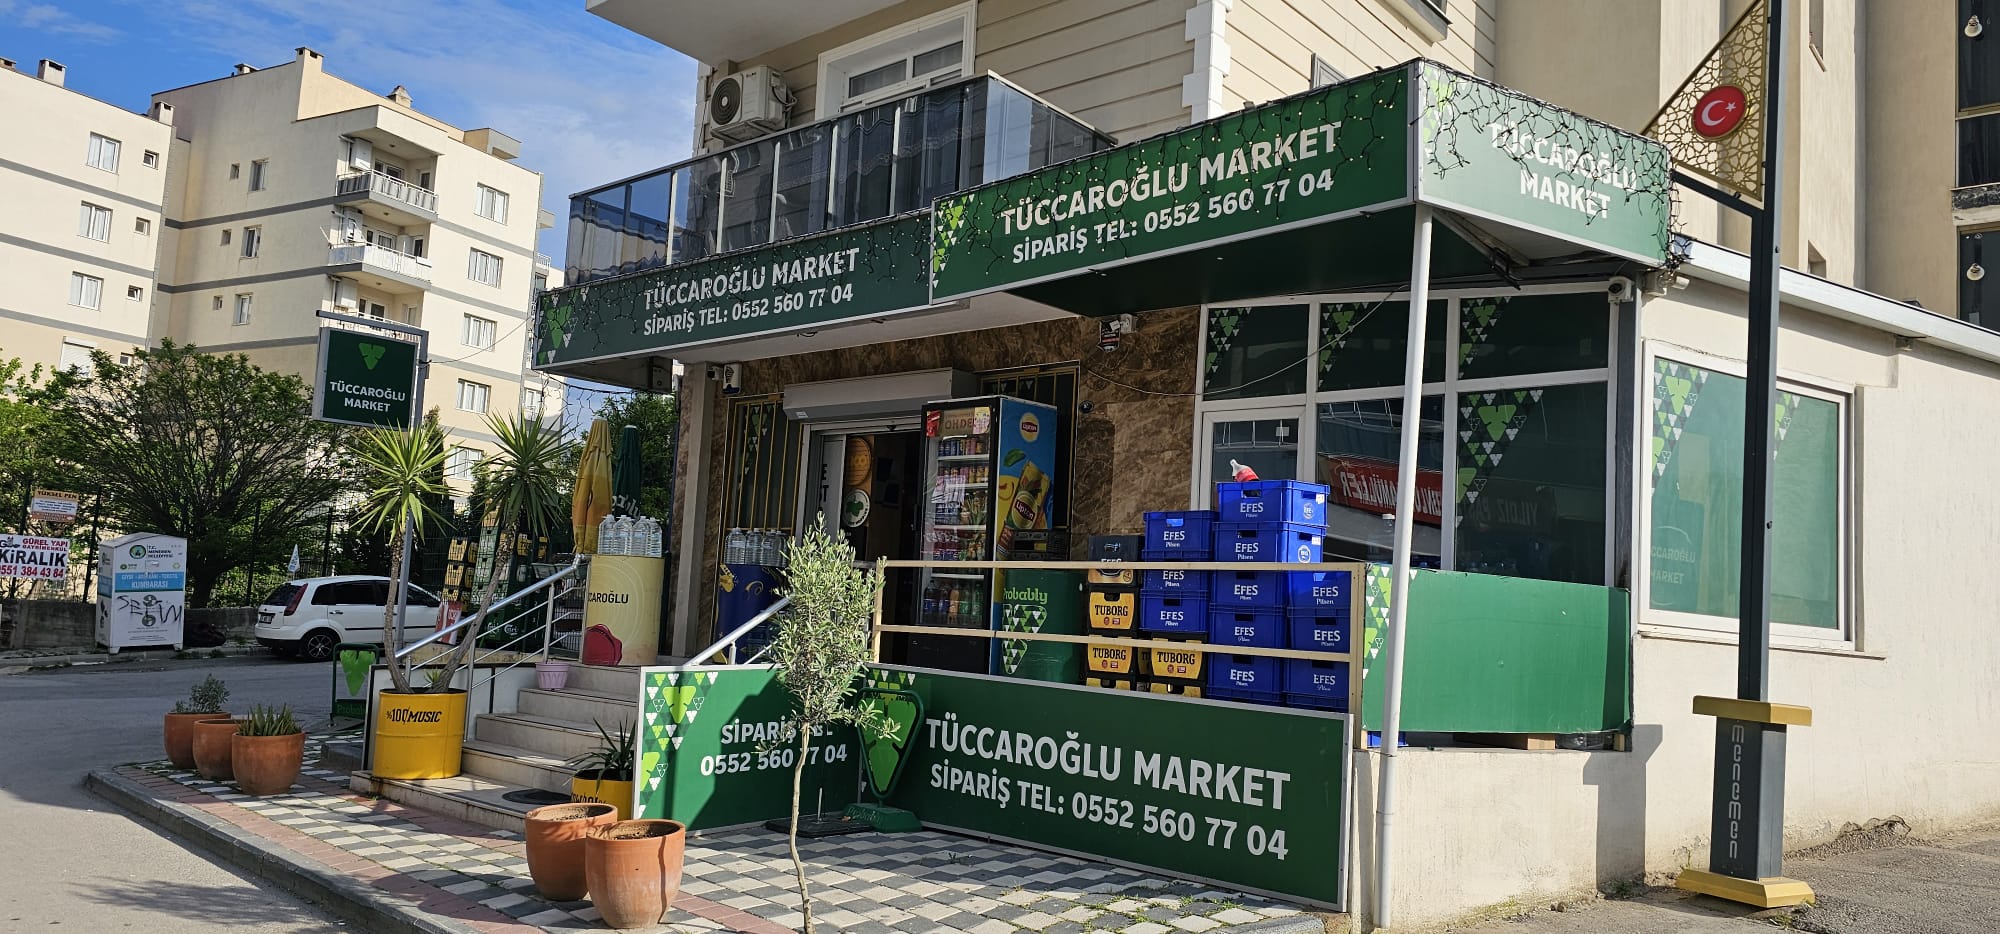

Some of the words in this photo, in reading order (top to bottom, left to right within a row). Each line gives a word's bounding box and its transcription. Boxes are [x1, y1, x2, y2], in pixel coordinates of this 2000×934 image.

[1488, 121, 1637, 192] TÜCCAROĞLU
[1001, 163, 1188, 235] TÜCCAROĞLU
[1200, 121, 1342, 186] MARKET
[1520, 170, 1610, 219] MARKET
[1013, 224, 1088, 263] SİPARİŞ
[1094, 218, 1137, 243] TEL:
[1144, 202, 1201, 233] 0552
[1208, 188, 1254, 219] 560
[1262, 178, 1291, 206] 77
[1299, 169, 1334, 197] 04
[643, 266, 766, 310] TÜCCAROĞLU
[772, 248, 860, 286] MARKET
[643, 308, 695, 336] SİPARİŞ
[699, 307, 728, 327] TEL:
[732, 299, 769, 321] 0552
[774, 292, 804, 314] 560
[808, 288, 826, 308] 77
[831, 284, 853, 304] 04
[330, 380, 406, 401] TÜCCAROĞLU
[344, 398, 391, 412] MARKET
[1240, 502, 1264, 513] EFES
[22, 537, 49, 546] GÜREL
[1163, 531, 1185, 541] EFES
[1235, 542, 1259, 553] EFES
[0, 564, 17, 575] 551
[21, 566, 38, 577] 384
[40, 567, 51, 577] 43
[53, 568, 64, 578] 84
[1163, 570, 1185, 580] EFES
[1234, 585, 1258, 595] EFES
[1312, 586, 1339, 597] EFES
[1094, 604, 1128, 617] TUBORG
[1160, 611, 1184, 621] EFES
[1234, 627, 1255, 637] EFES
[1314, 630, 1341, 642] EFES
[1092, 647, 1127, 660] TUBORG
[1156, 652, 1195, 665] TUBORG
[1230, 669, 1255, 682] EFES
[1313, 674, 1336, 686] EFES
[408, 711, 442, 723] MUSIC
[720, 715, 797, 744] SİPARİŞ
[700, 752, 751, 776] 0552
[757, 749, 794, 770] 560
[800, 746, 820, 765] 7
[824, 744, 848, 763] 04
[926, 712, 1122, 781] TÜCCAROĞLU
[1134, 750, 1291, 810] MARKET
[1729, 724, 1745, 859] menemen
[930, 758, 1011, 808] SİPARİŞ
[1017, 780, 1065, 815] TEL:
[1072, 792, 1134, 829] 0552
[1143, 805, 1196, 843] 560
[1205, 816, 1238, 850] 77
[1246, 825, 1289, 861] 04
